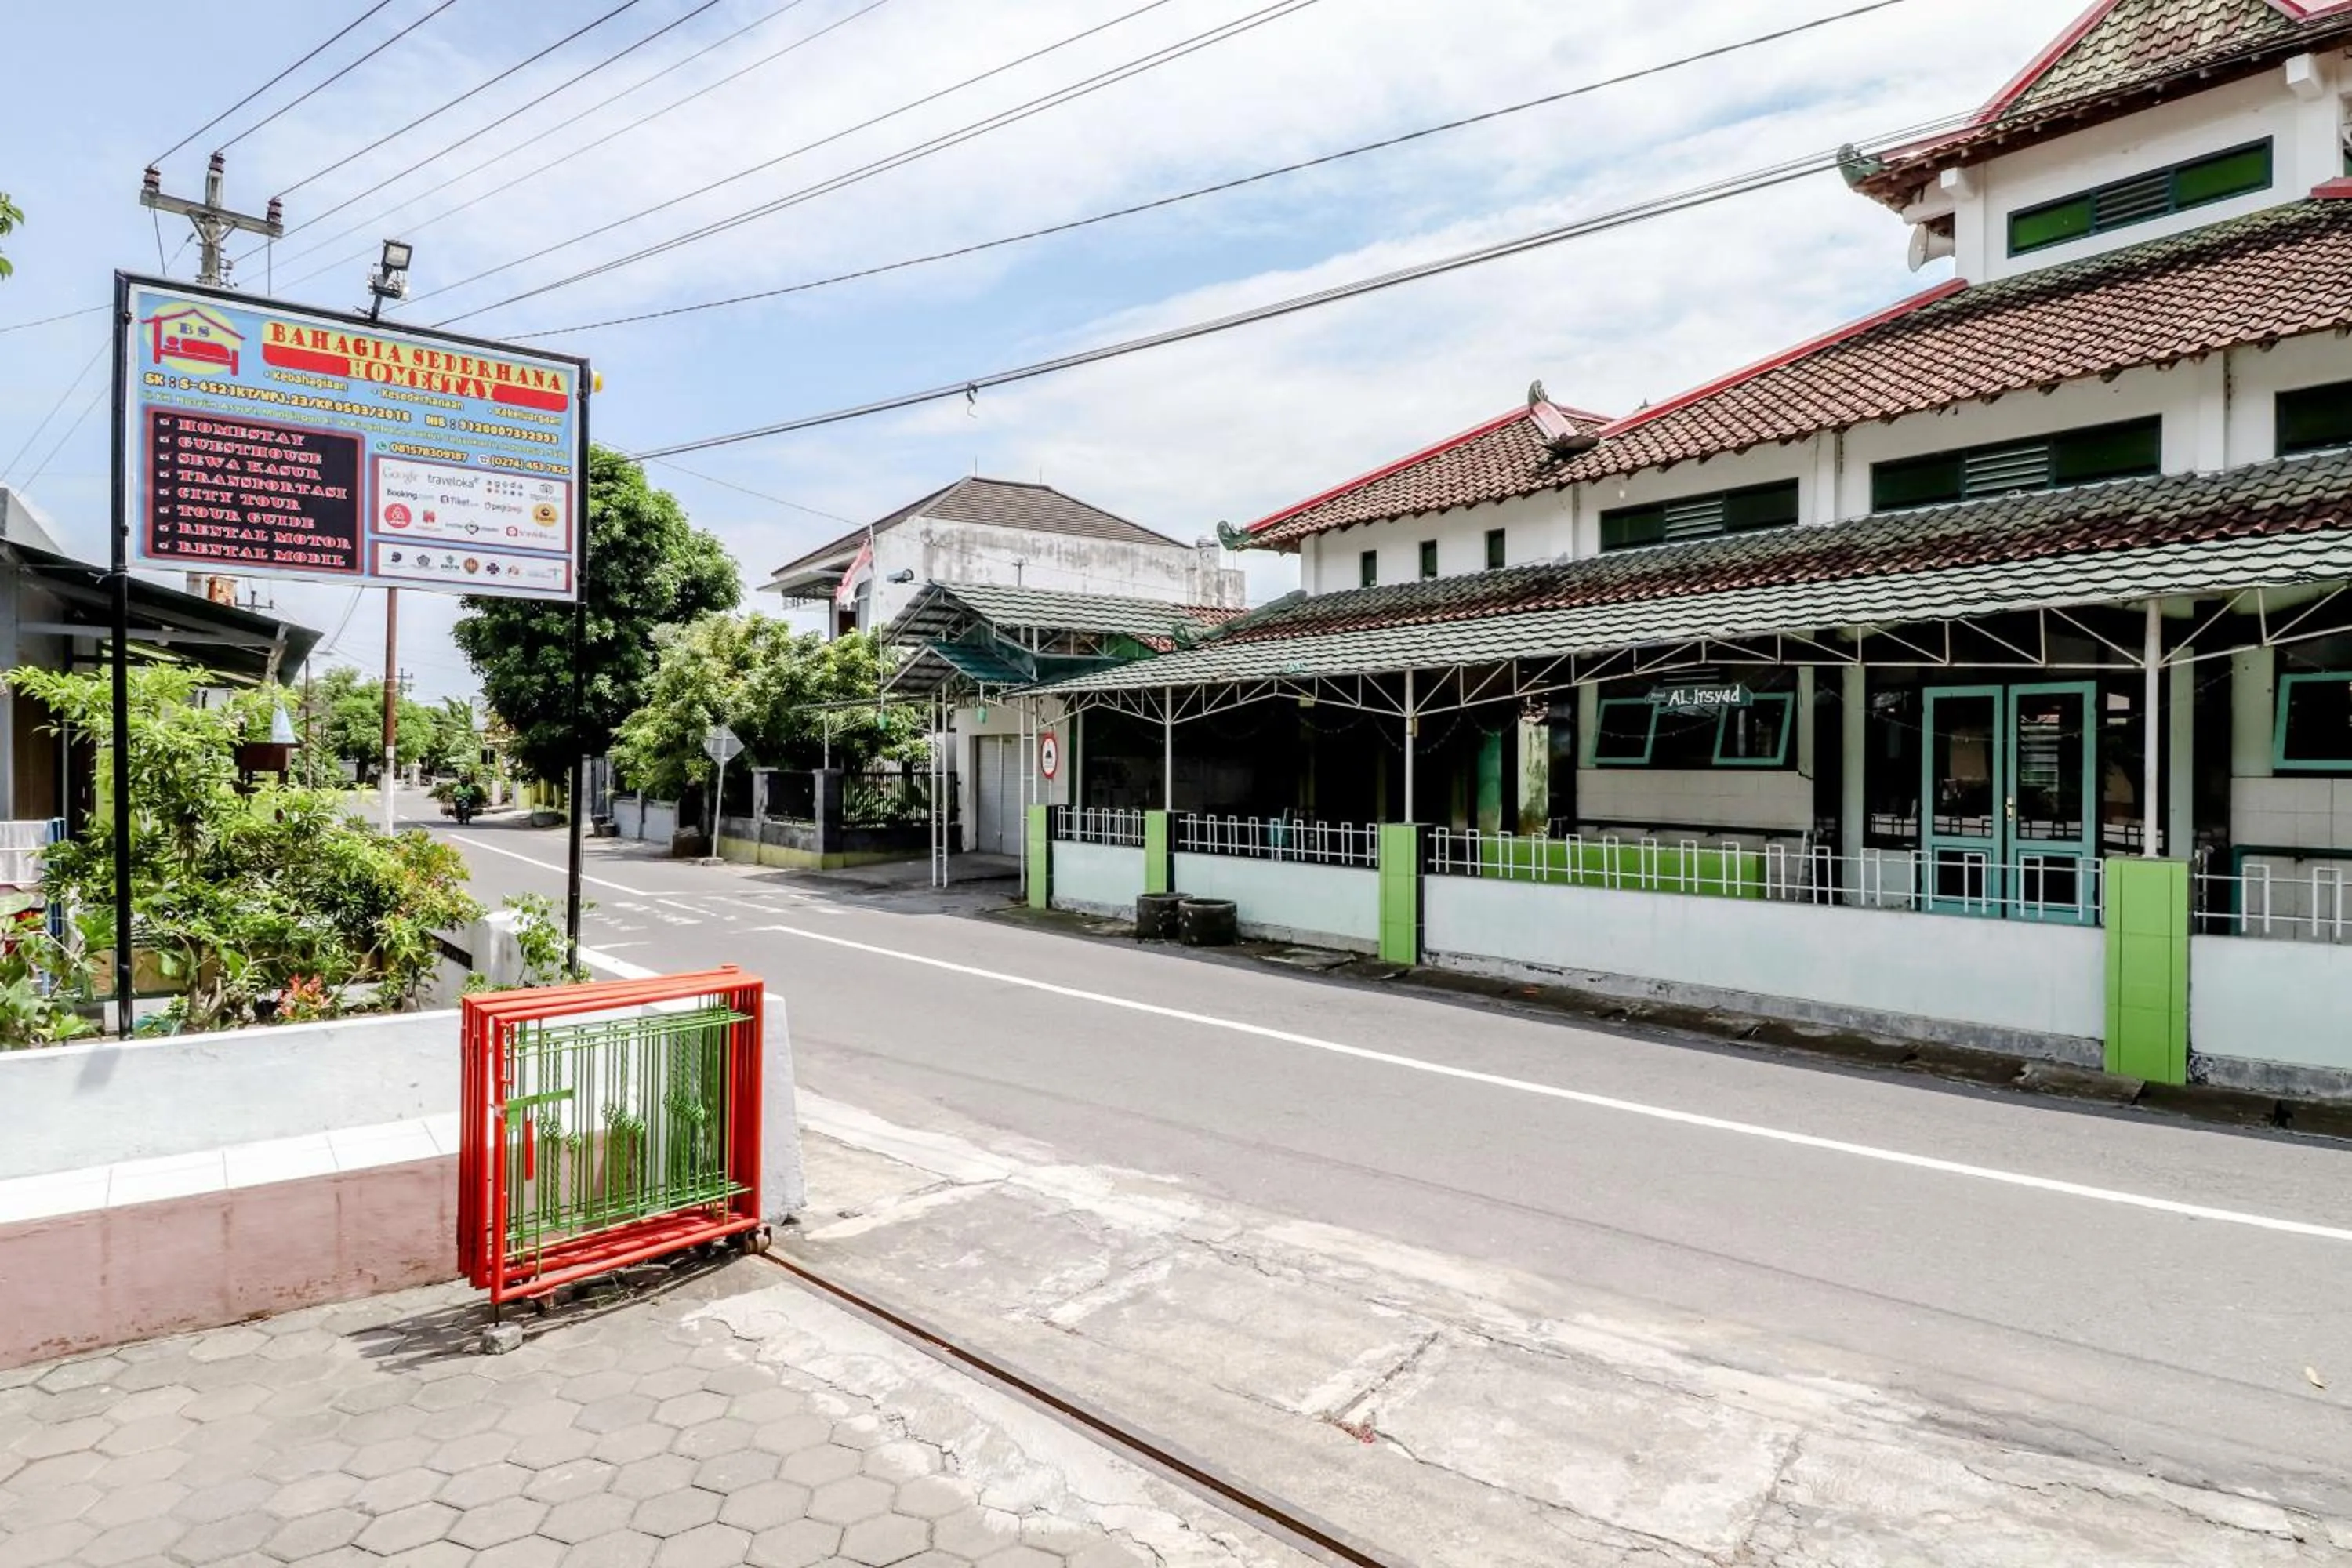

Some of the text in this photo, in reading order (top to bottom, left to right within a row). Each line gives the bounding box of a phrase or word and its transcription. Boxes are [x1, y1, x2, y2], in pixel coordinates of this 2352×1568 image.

[270, 322, 562, 390] BAHAGIA SEDERHANA
[144, 372, 165, 387] SK
[274, 371, 348, 392] Kebahagiaan
[348, 357, 498, 401] HOMESTAY
[381, 388, 465, 411] Kesederhanaan
[178, 419, 305, 446] HOMESTAY
[425, 414, 447, 428] NIB
[178, 436, 323, 464] GUESTHOUSE
[178, 452, 321, 480] SEWA KASUR
[177, 470, 347, 499] TRANSPORTASI
[427, 474, 474, 488] traveloka
[177, 487, 302, 510] CITY TOUR
[177, 504, 315, 529] TOUR GUIDE
[178, 522, 351, 550] RENTAL MOTOR
[177, 540, 346, 566] RENTAL MOBIL
